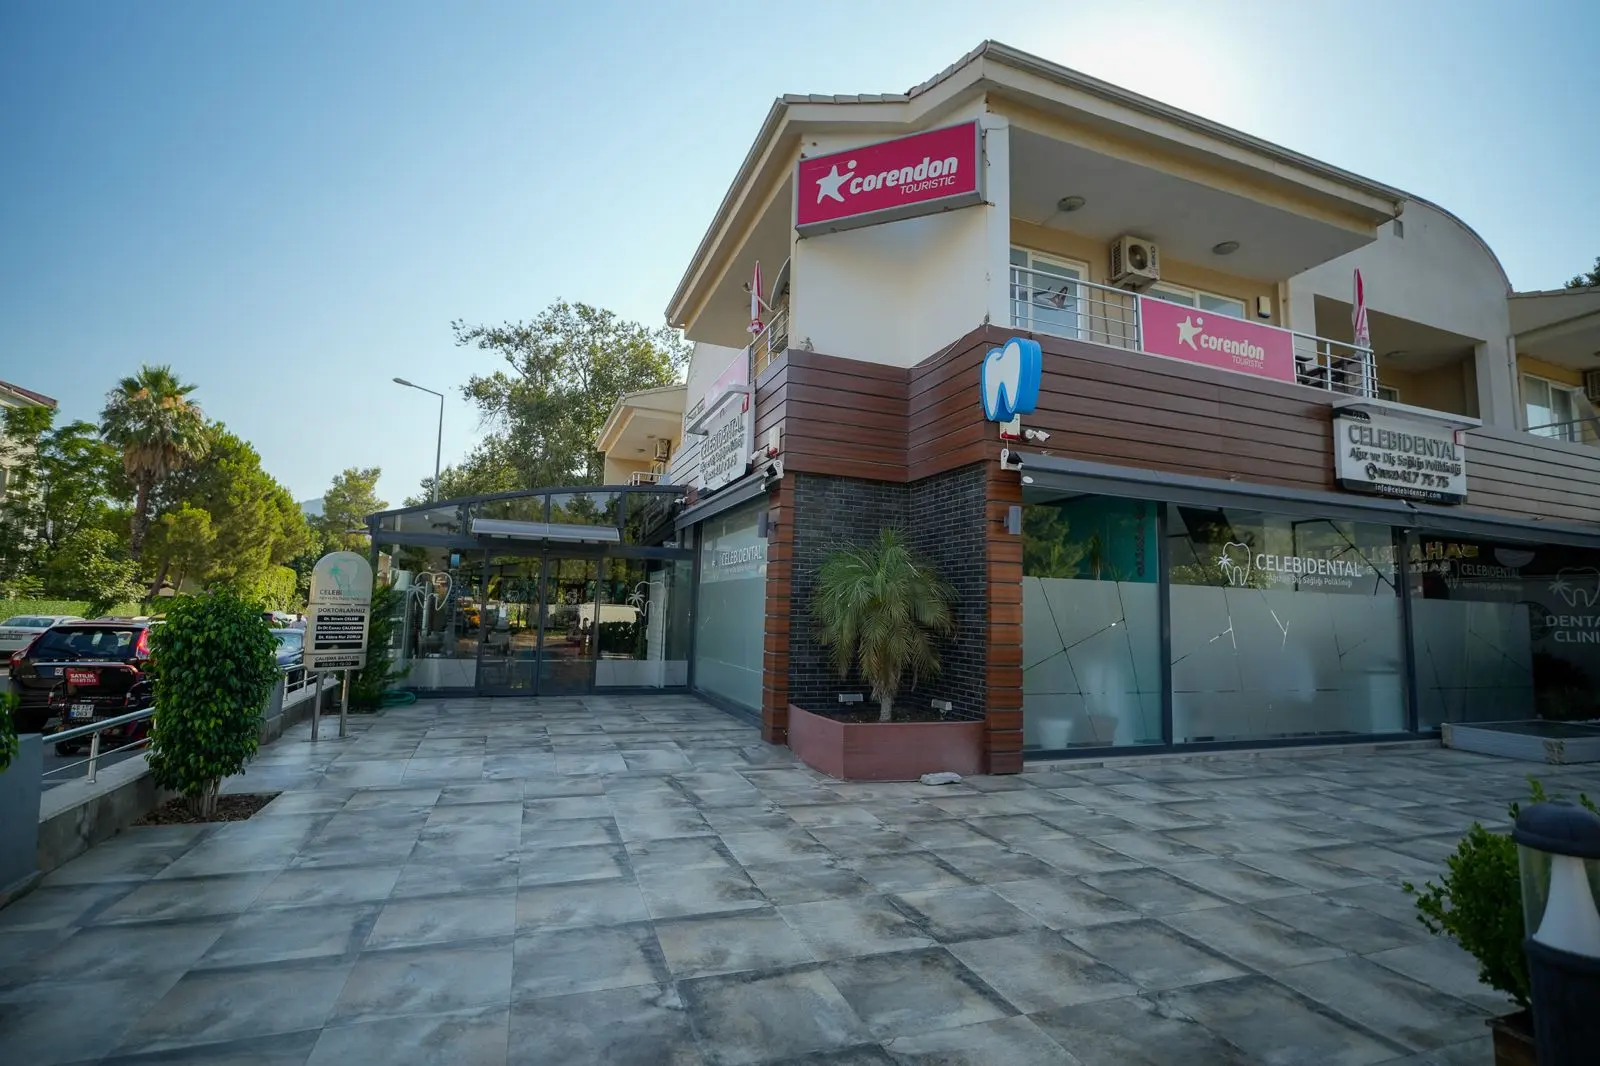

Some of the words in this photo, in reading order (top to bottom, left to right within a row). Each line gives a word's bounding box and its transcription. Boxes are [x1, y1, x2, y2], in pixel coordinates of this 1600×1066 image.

[850, 156, 958, 194] corendon
[900, 175, 956, 195] TOURISTIC
[1200, 334, 1265, 360] corendon
[1232, 355, 1264, 369] TOURISTIC
